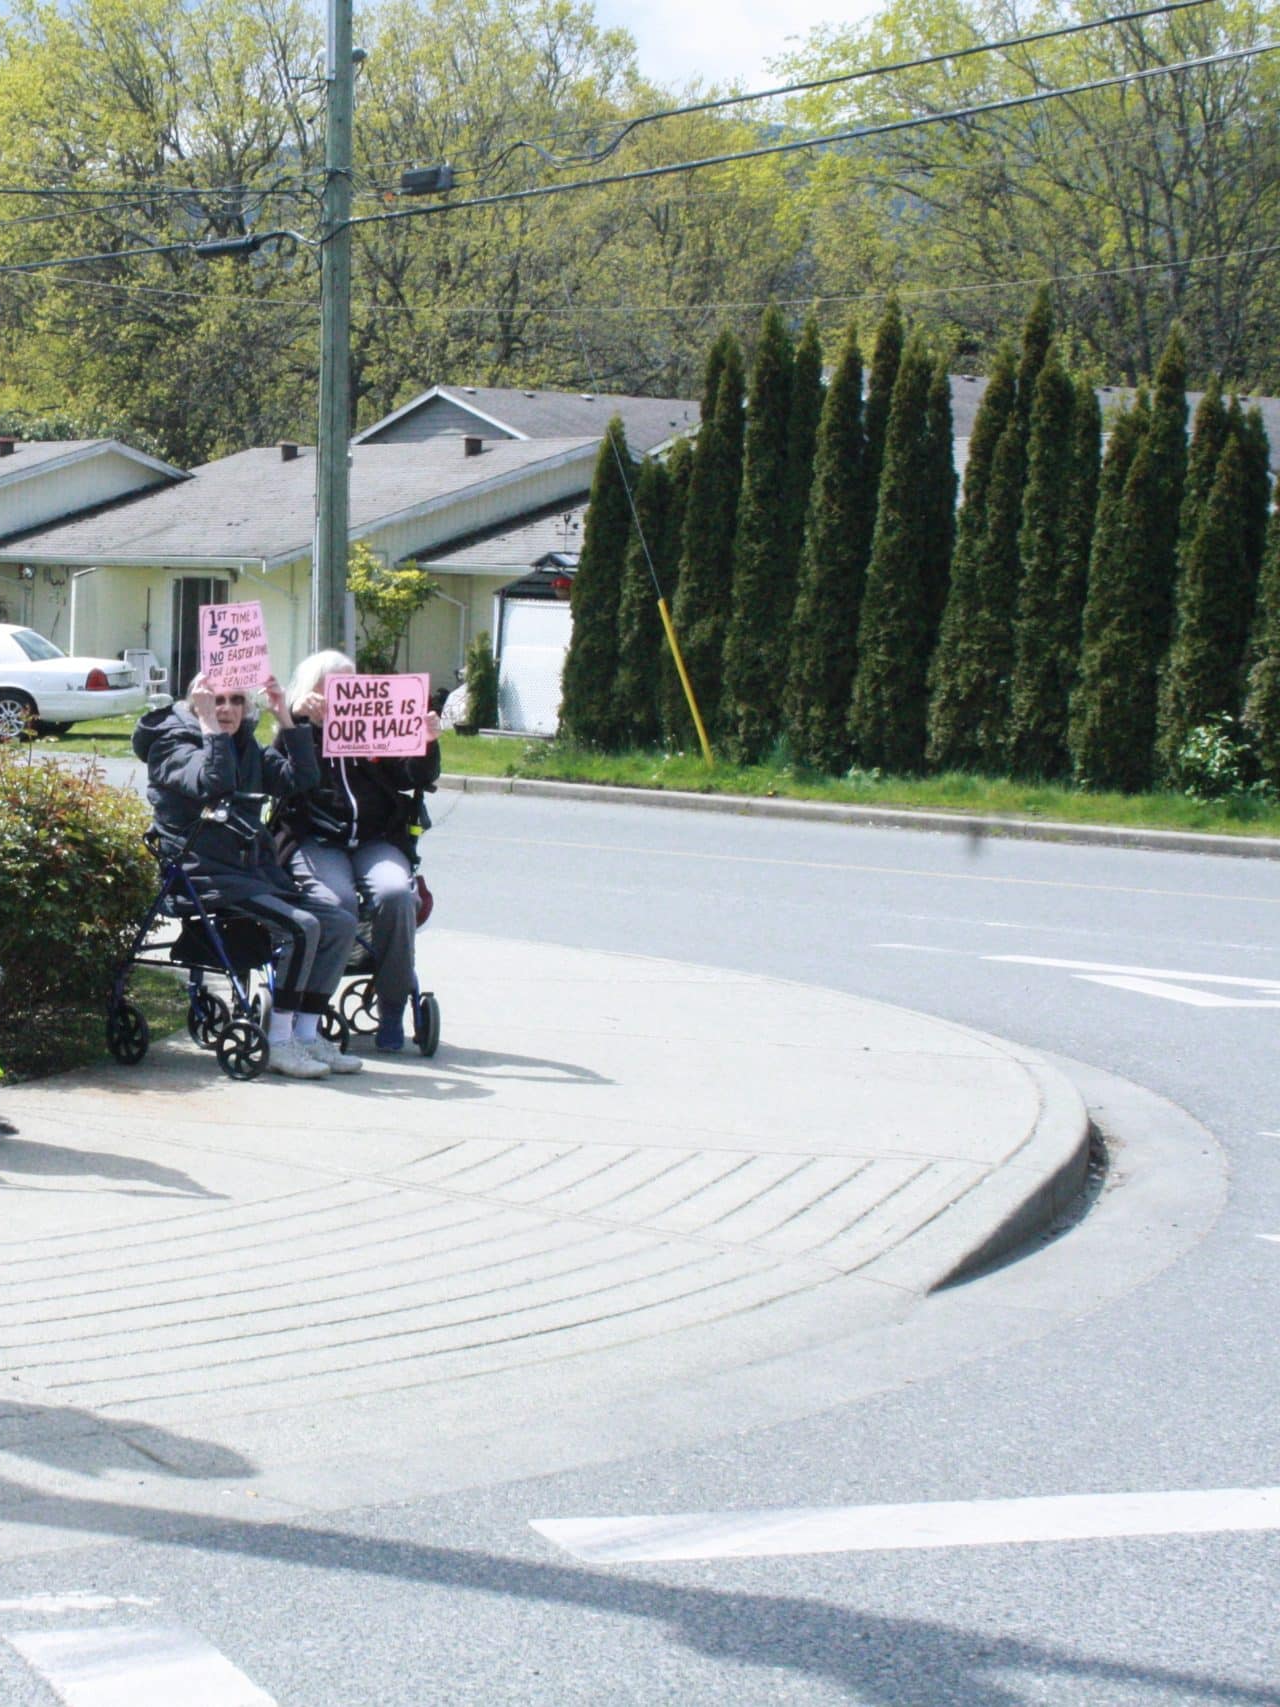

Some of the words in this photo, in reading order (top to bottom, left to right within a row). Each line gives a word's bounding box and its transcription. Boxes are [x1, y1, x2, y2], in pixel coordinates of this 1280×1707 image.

[230, 610, 251, 625] TIME
[219, 627, 239, 645] 50
[240, 626, 261, 641] YEARS
[209, 650, 225, 664] NO
[227, 646, 254, 662] EASTER
[208, 667, 223, 679] FOR
[223, 673, 258, 688] SENIORS
[336, 681, 390, 701] NAHS
[333, 700, 394, 717] WHERE
[400, 699, 416, 715] IS
[328, 719, 366, 743] OUR
[372, 716, 423, 739] HALL?
